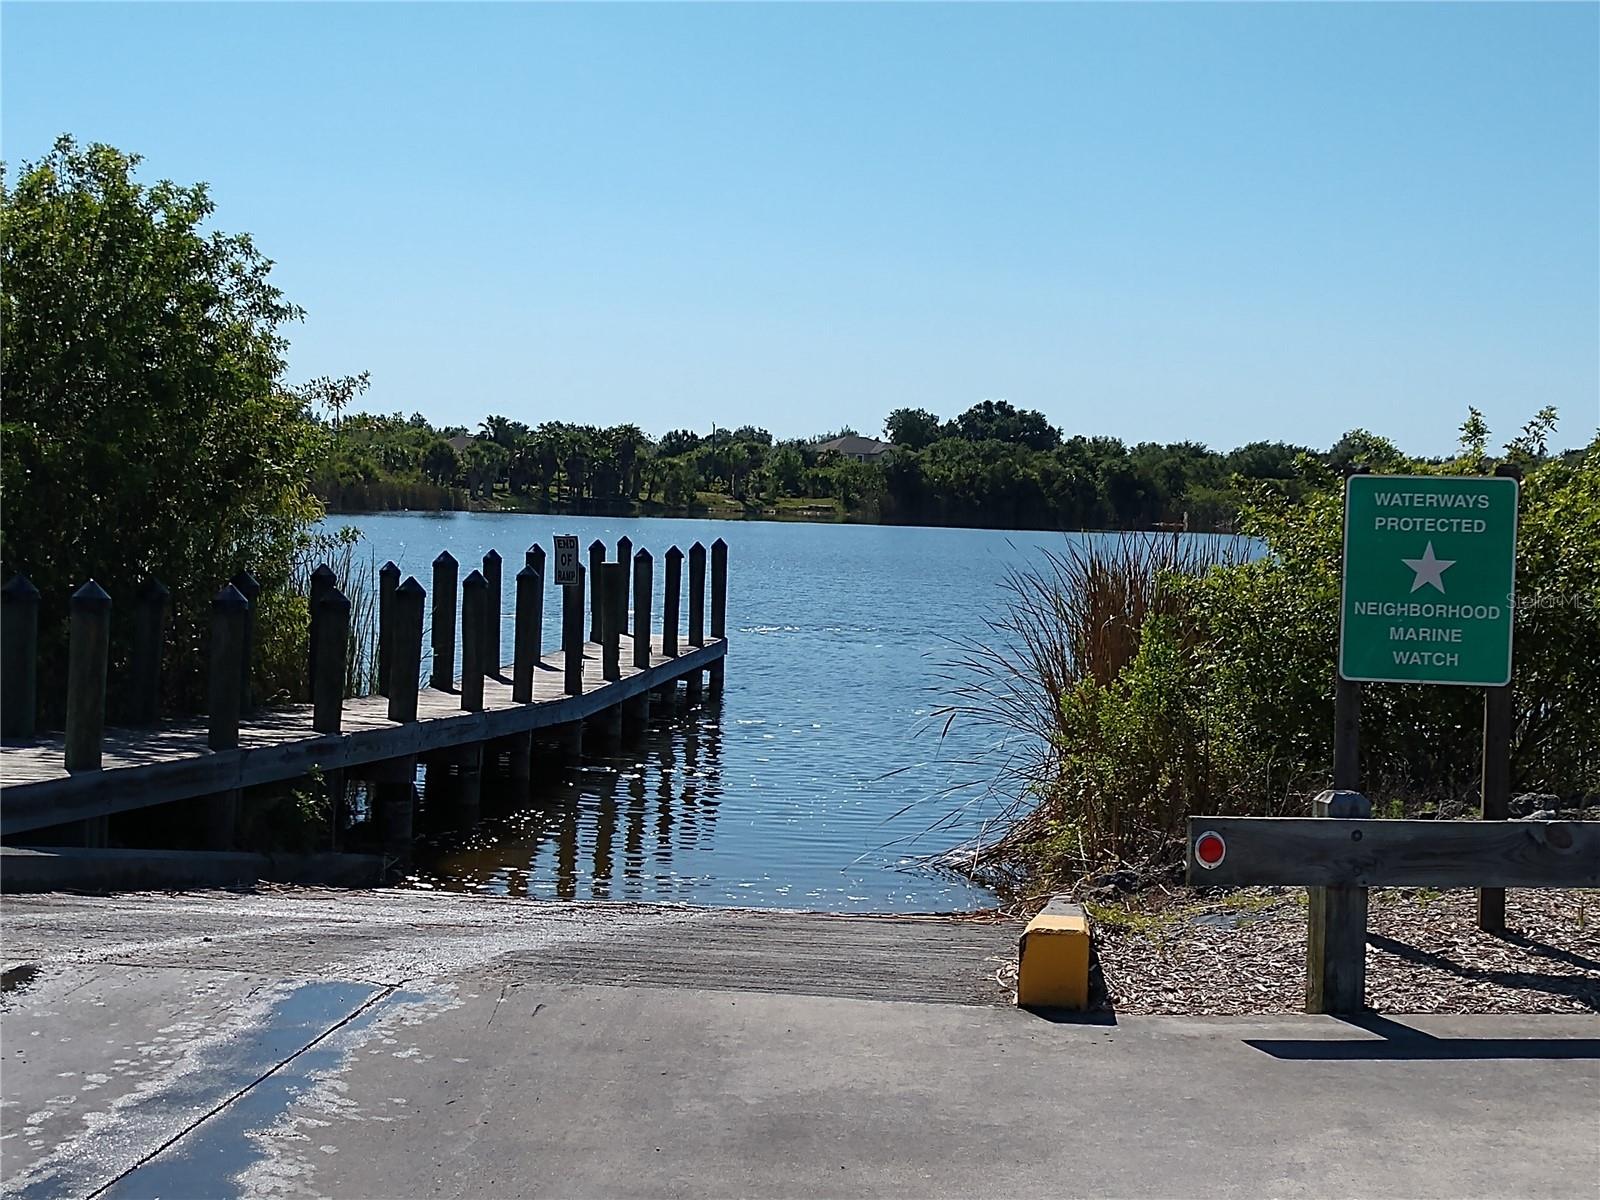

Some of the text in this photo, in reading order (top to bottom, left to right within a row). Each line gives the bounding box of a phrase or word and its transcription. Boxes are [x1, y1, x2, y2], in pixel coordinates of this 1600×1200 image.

[1374, 492, 1490, 509] WATERWAYS
[1374, 517, 1486, 533] PROTECTED
[557, 539, 575, 549] END
[560, 553, 573, 566] OF
[557, 570, 576, 581] RAMP
[1354, 601, 1500, 619] NEIGHBORHOOD
[1389, 627, 1462, 642] MARINE
[1393, 651, 1459, 666] WATCH
